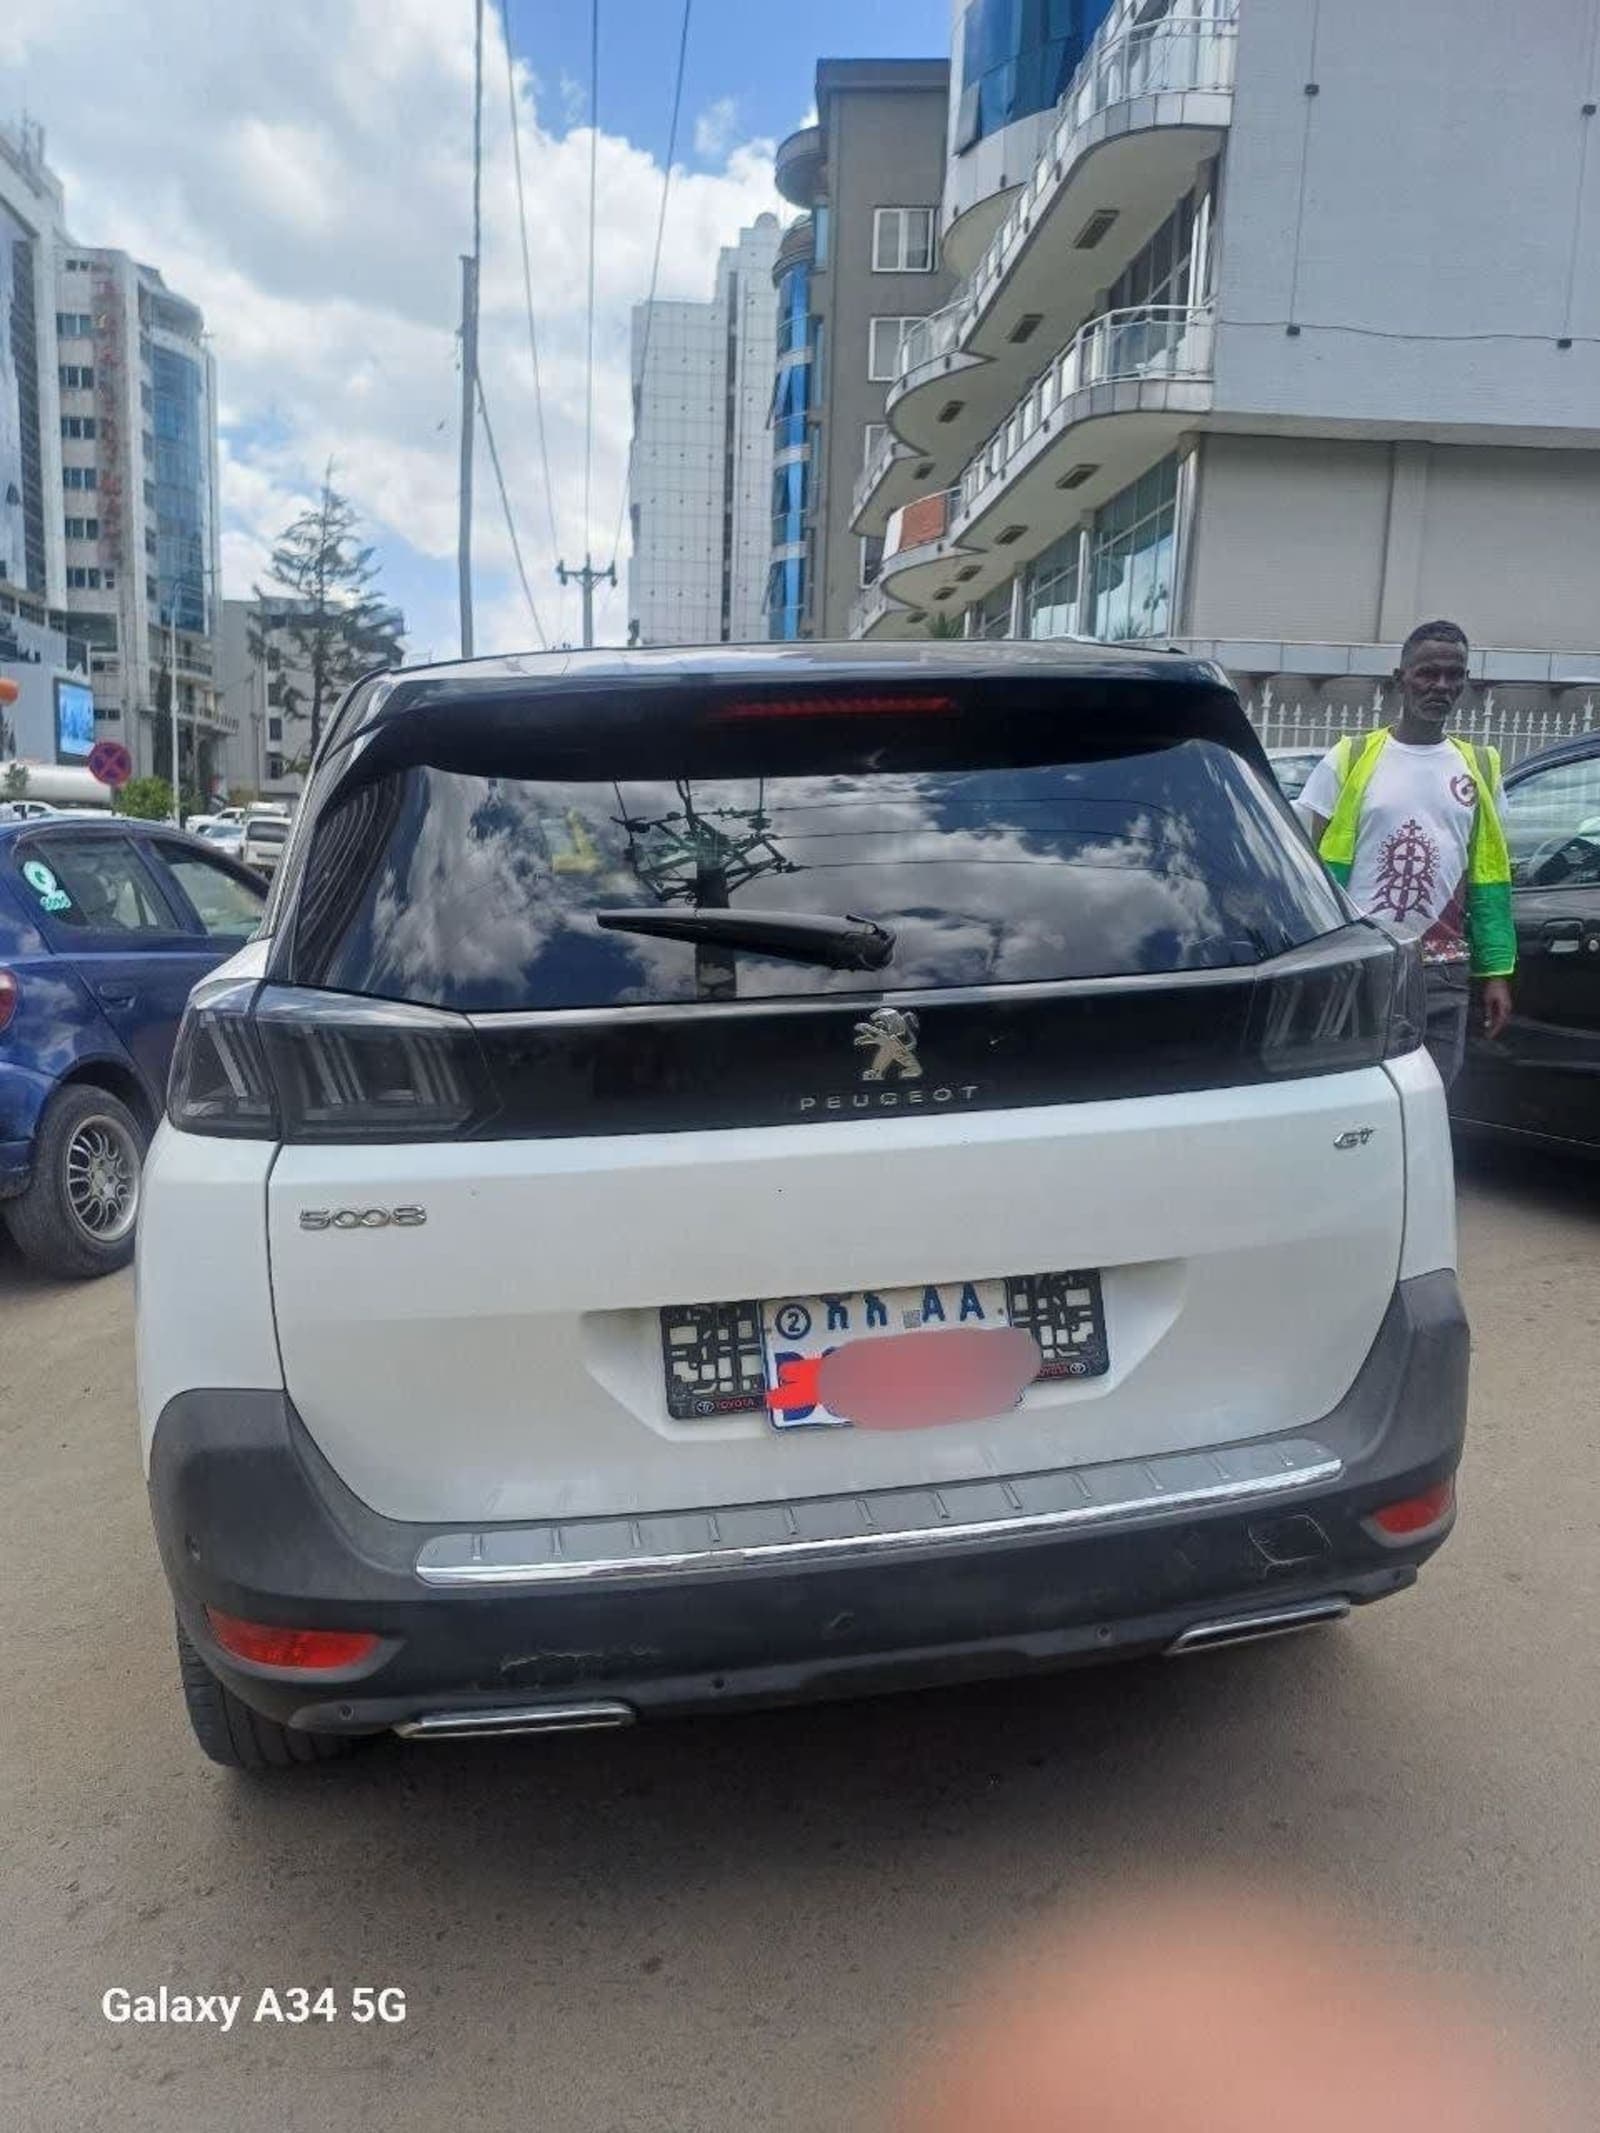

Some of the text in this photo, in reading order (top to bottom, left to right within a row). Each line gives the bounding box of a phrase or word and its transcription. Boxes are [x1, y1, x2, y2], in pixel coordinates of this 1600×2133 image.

[800, 1085, 980, 1111] PEUGEOT
[1333, 1127, 1375, 1149] GT
[300, 1205, 427, 1231] 5008
[922, 1282, 985, 1322] AA
